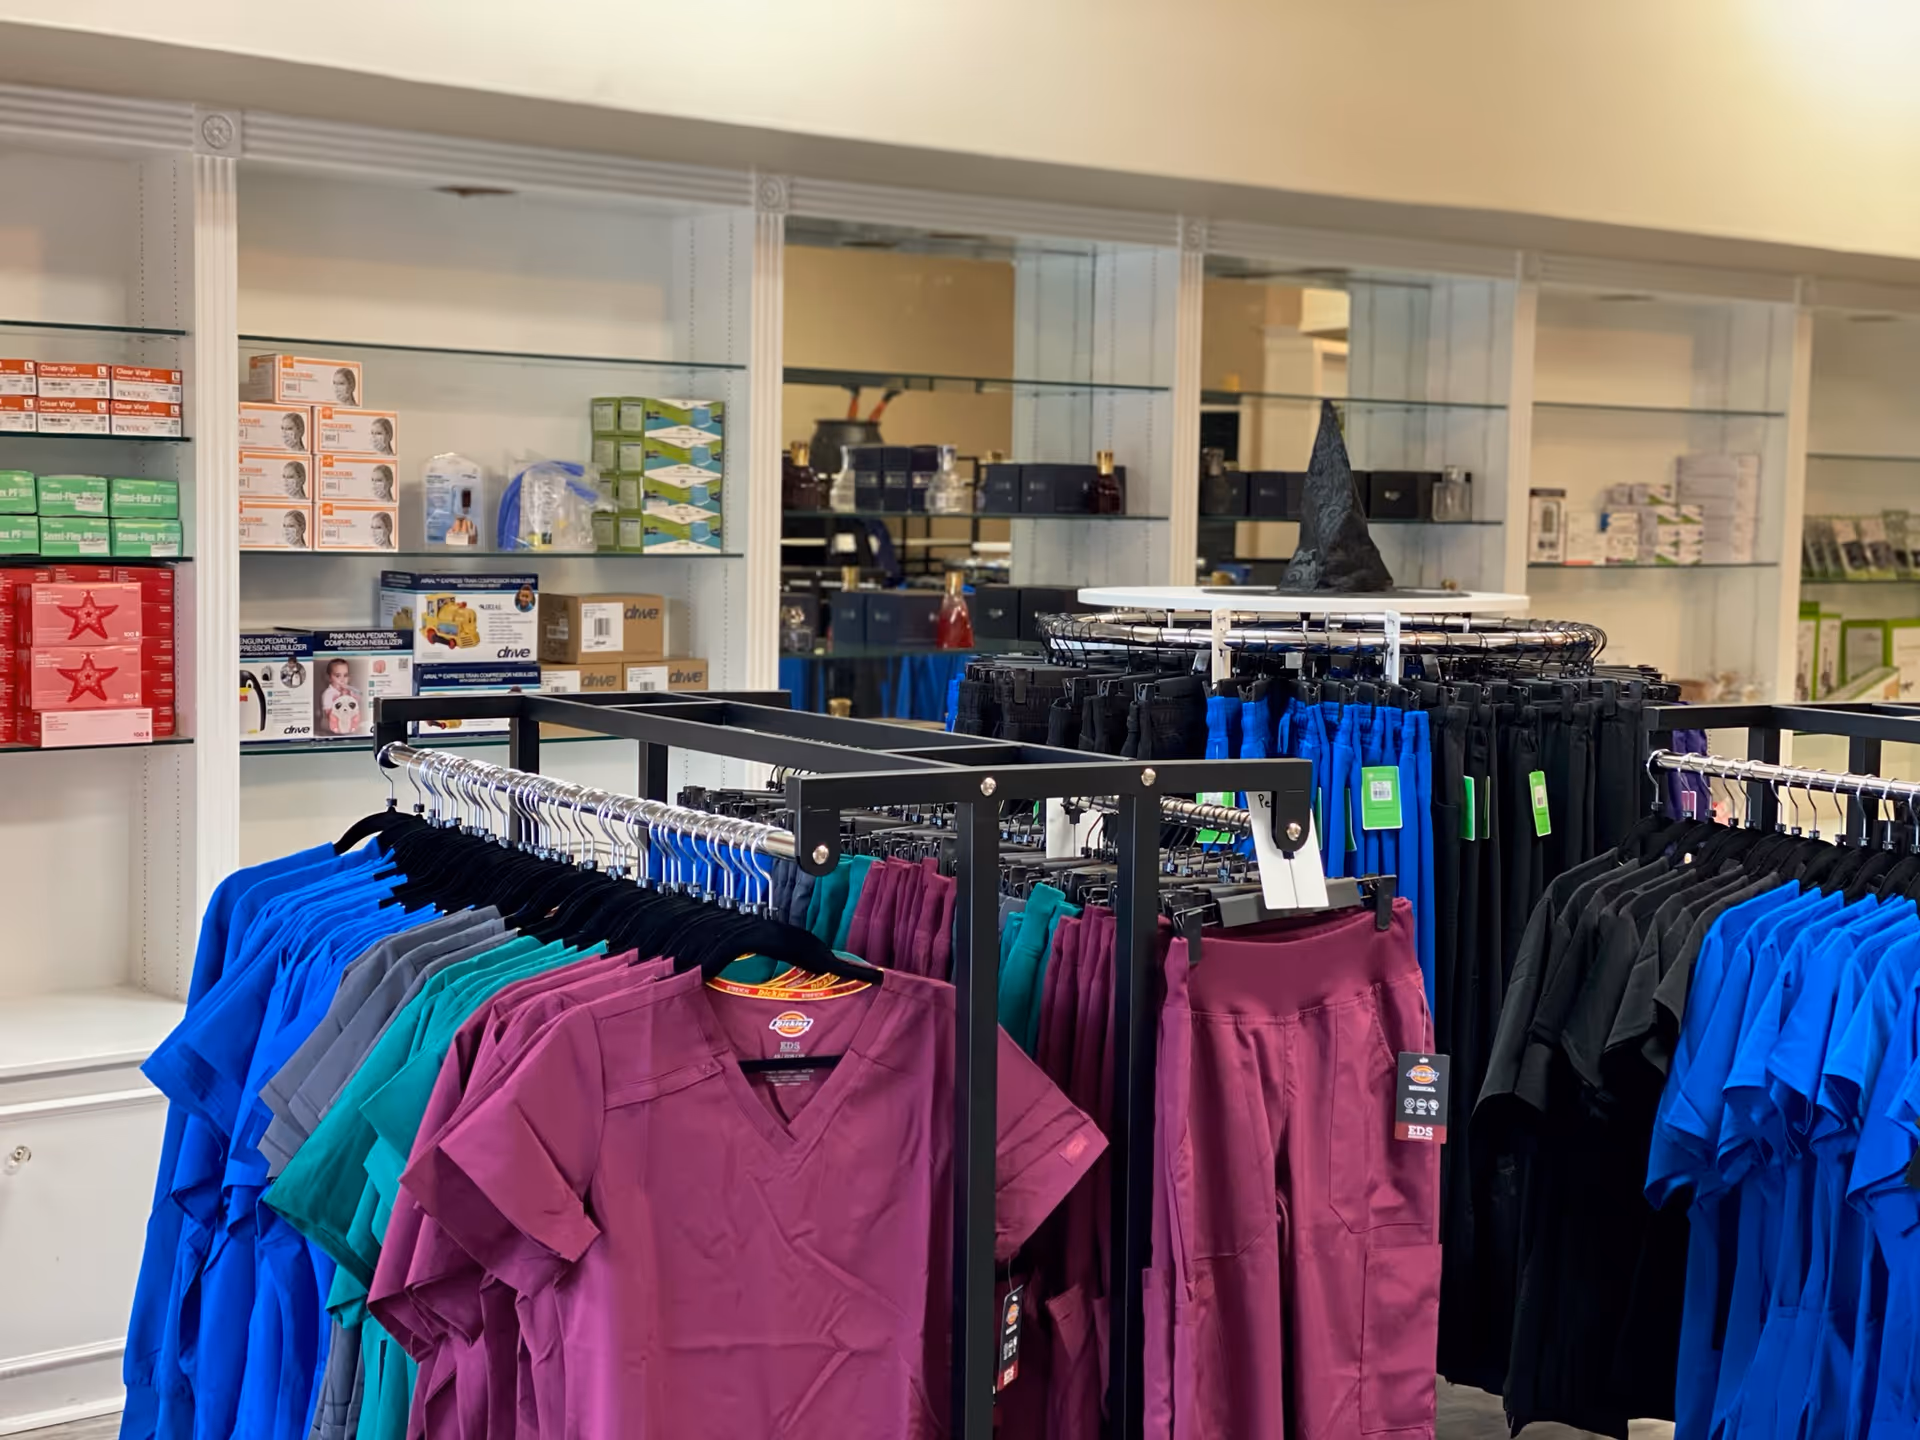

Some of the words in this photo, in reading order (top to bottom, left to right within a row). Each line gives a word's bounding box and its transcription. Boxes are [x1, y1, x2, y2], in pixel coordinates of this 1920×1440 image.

[135, 369, 151, 377] Vinyl
[624, 605, 659, 620] drive
[369, 638, 403, 646] NEBULIZER
[497, 646, 530, 658] drive
[581, 672, 617, 687] drive
[668, 669, 703, 684] drive
[284, 725, 310, 735] drive
[757, 989, 790, 998] Dickies
[780, 1041, 801, 1050] EDS
[1408, 1125, 1433, 1137] EDS
